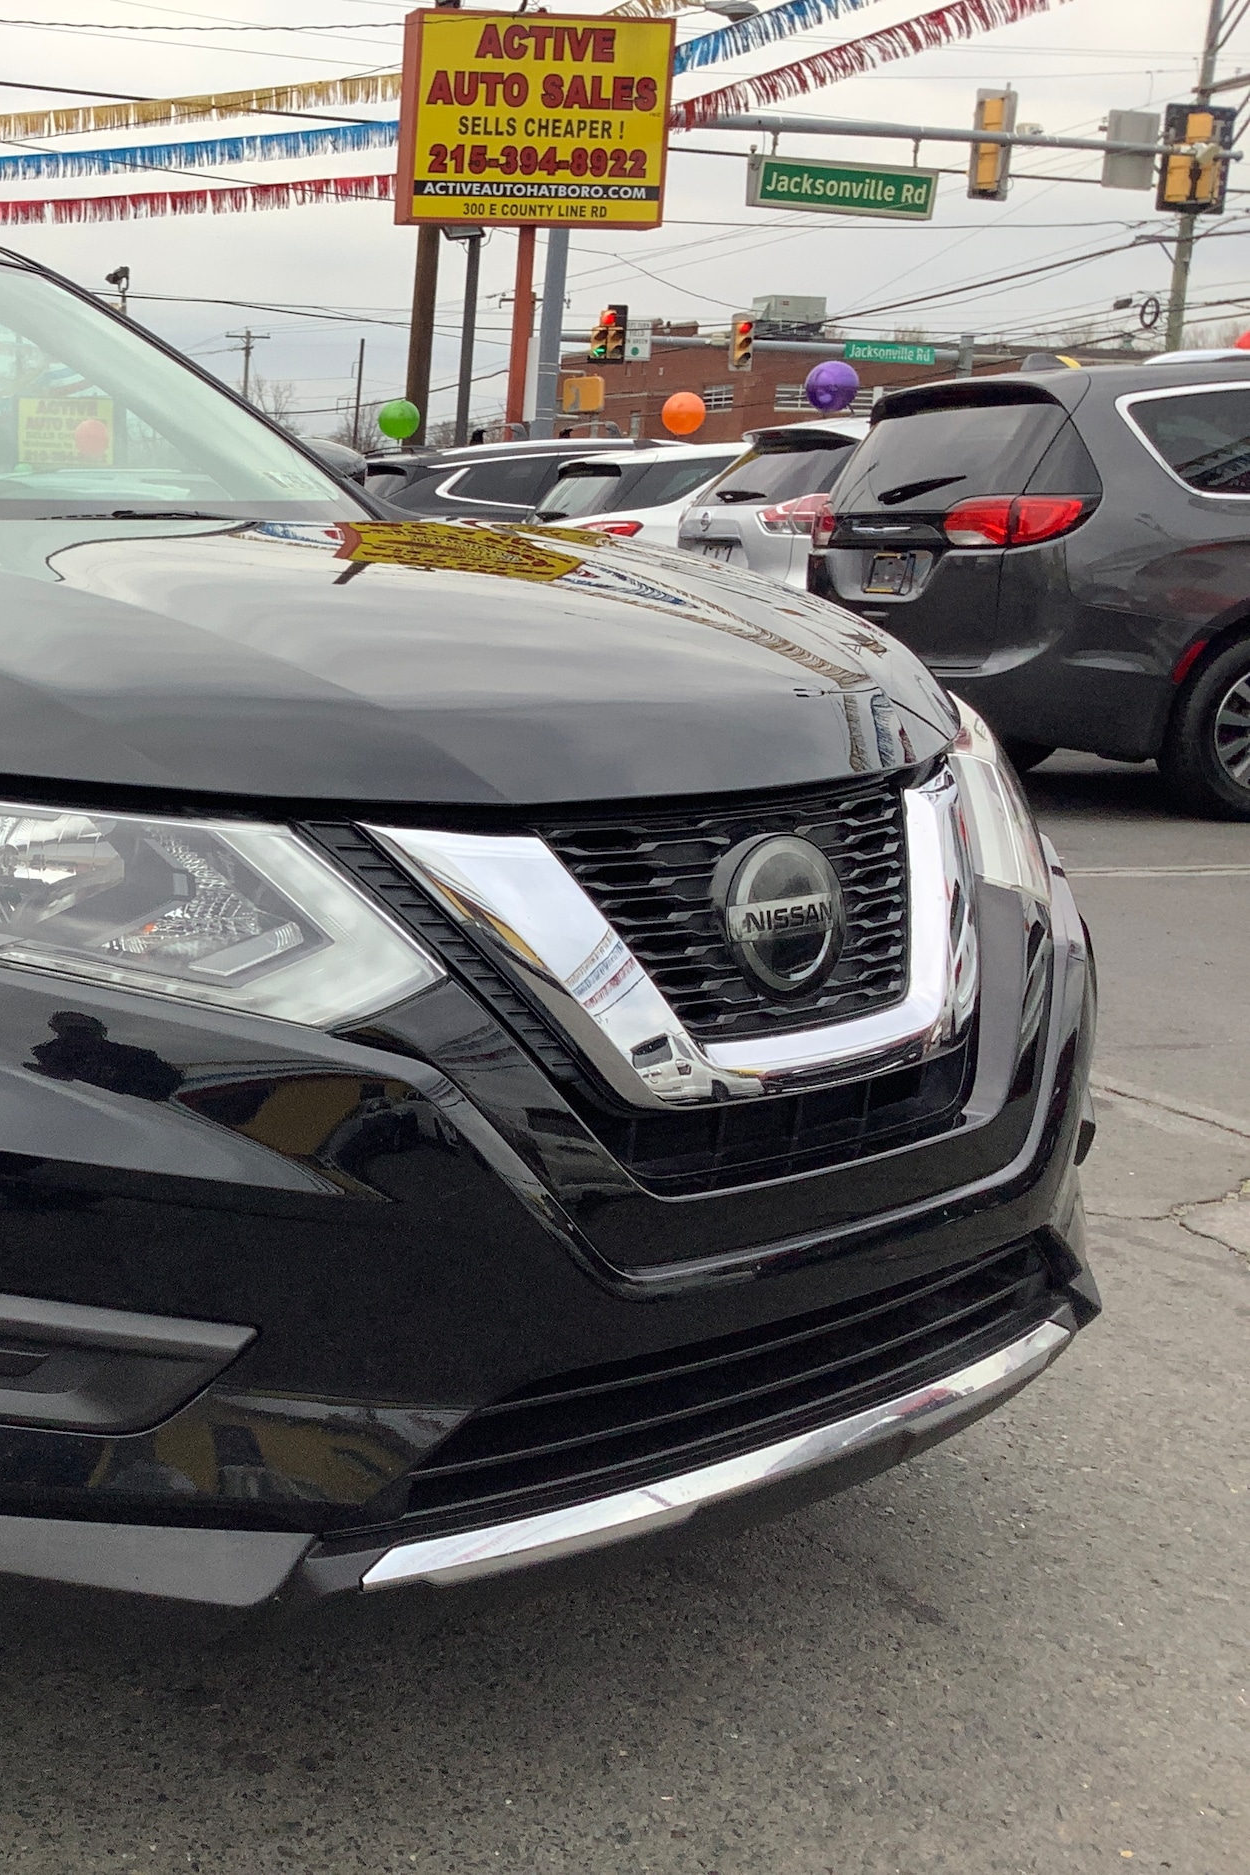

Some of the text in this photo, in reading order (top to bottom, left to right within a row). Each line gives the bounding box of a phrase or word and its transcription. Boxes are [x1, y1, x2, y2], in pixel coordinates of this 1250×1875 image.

[475, 23, 616, 63] ACTIVE
[426, 70, 658, 113] AUTO SALES
[458, 116, 625, 140] SELLS CHEAPER !
[428, 144, 647, 179] 215-394-8922
[423, 181, 647, 199] ACTIVEAUTOHATBORO.COM
[766, 171, 927, 204] Jacksonville Rd
[463, 203, 607, 218] 300 E COUNTY LINE RD
[849, 344, 930, 362] Jacksonville Rd
[745, 901, 832, 933] NISSAN
